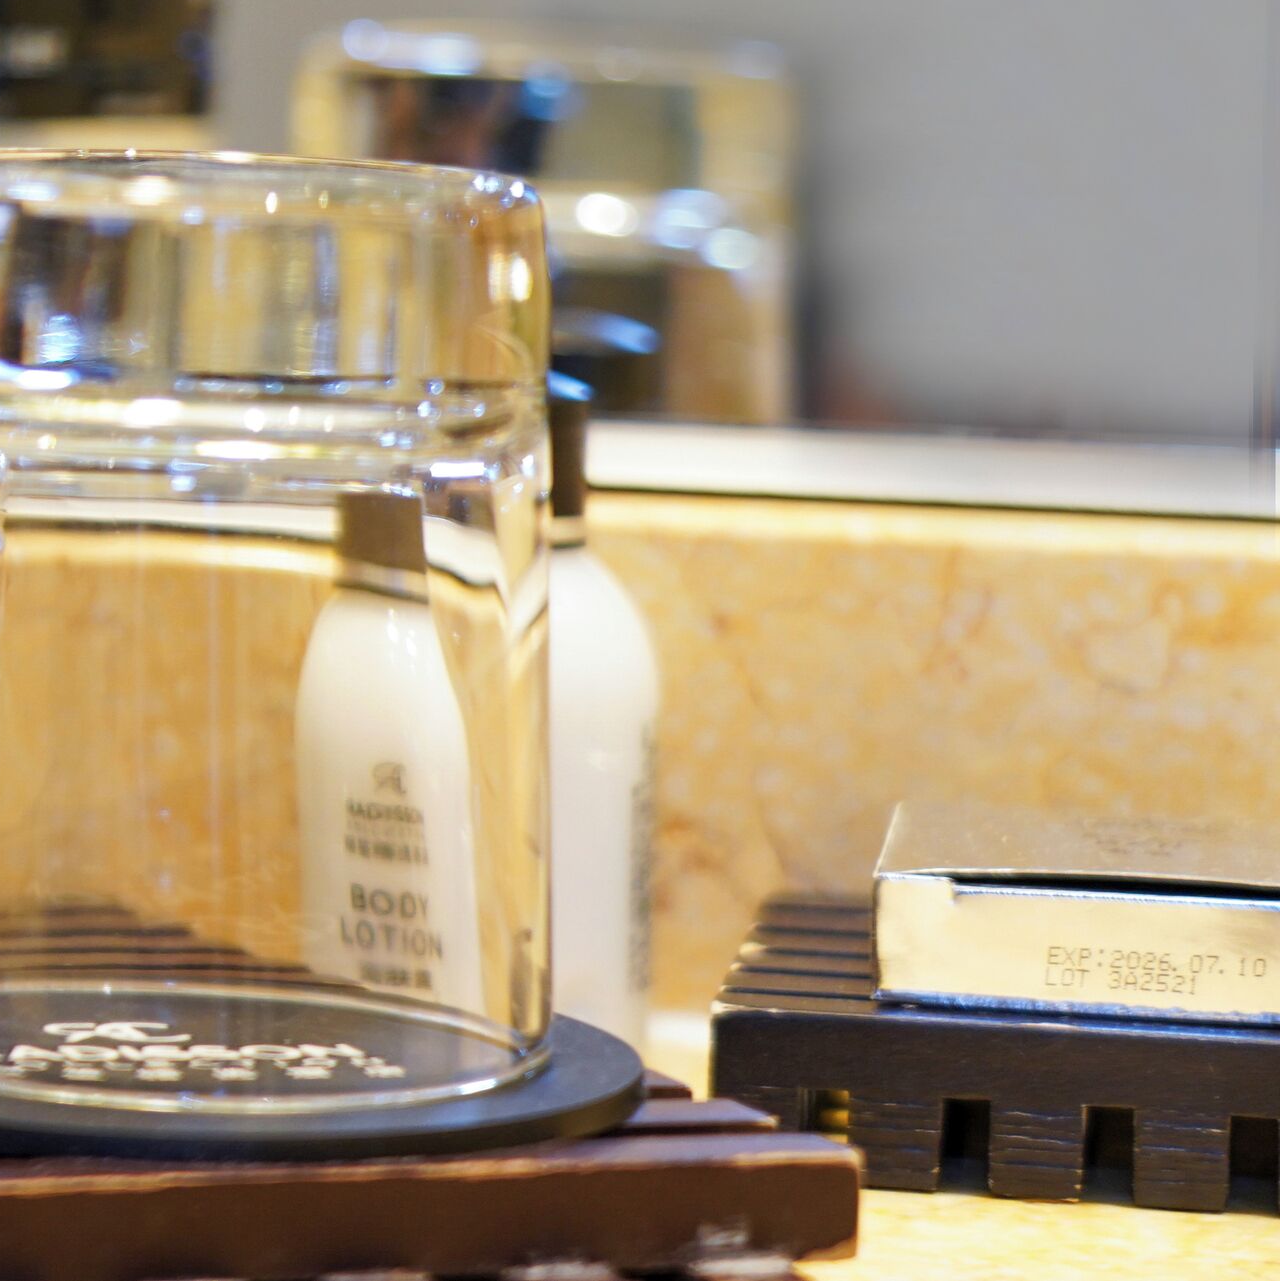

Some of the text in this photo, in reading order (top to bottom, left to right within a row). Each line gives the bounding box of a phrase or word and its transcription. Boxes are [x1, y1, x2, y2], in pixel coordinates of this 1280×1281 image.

[350, 883, 430, 920] BODY
[340, 917, 443, 959] LOTION
[1044, 966, 1197, 995] LOT 3A2521
